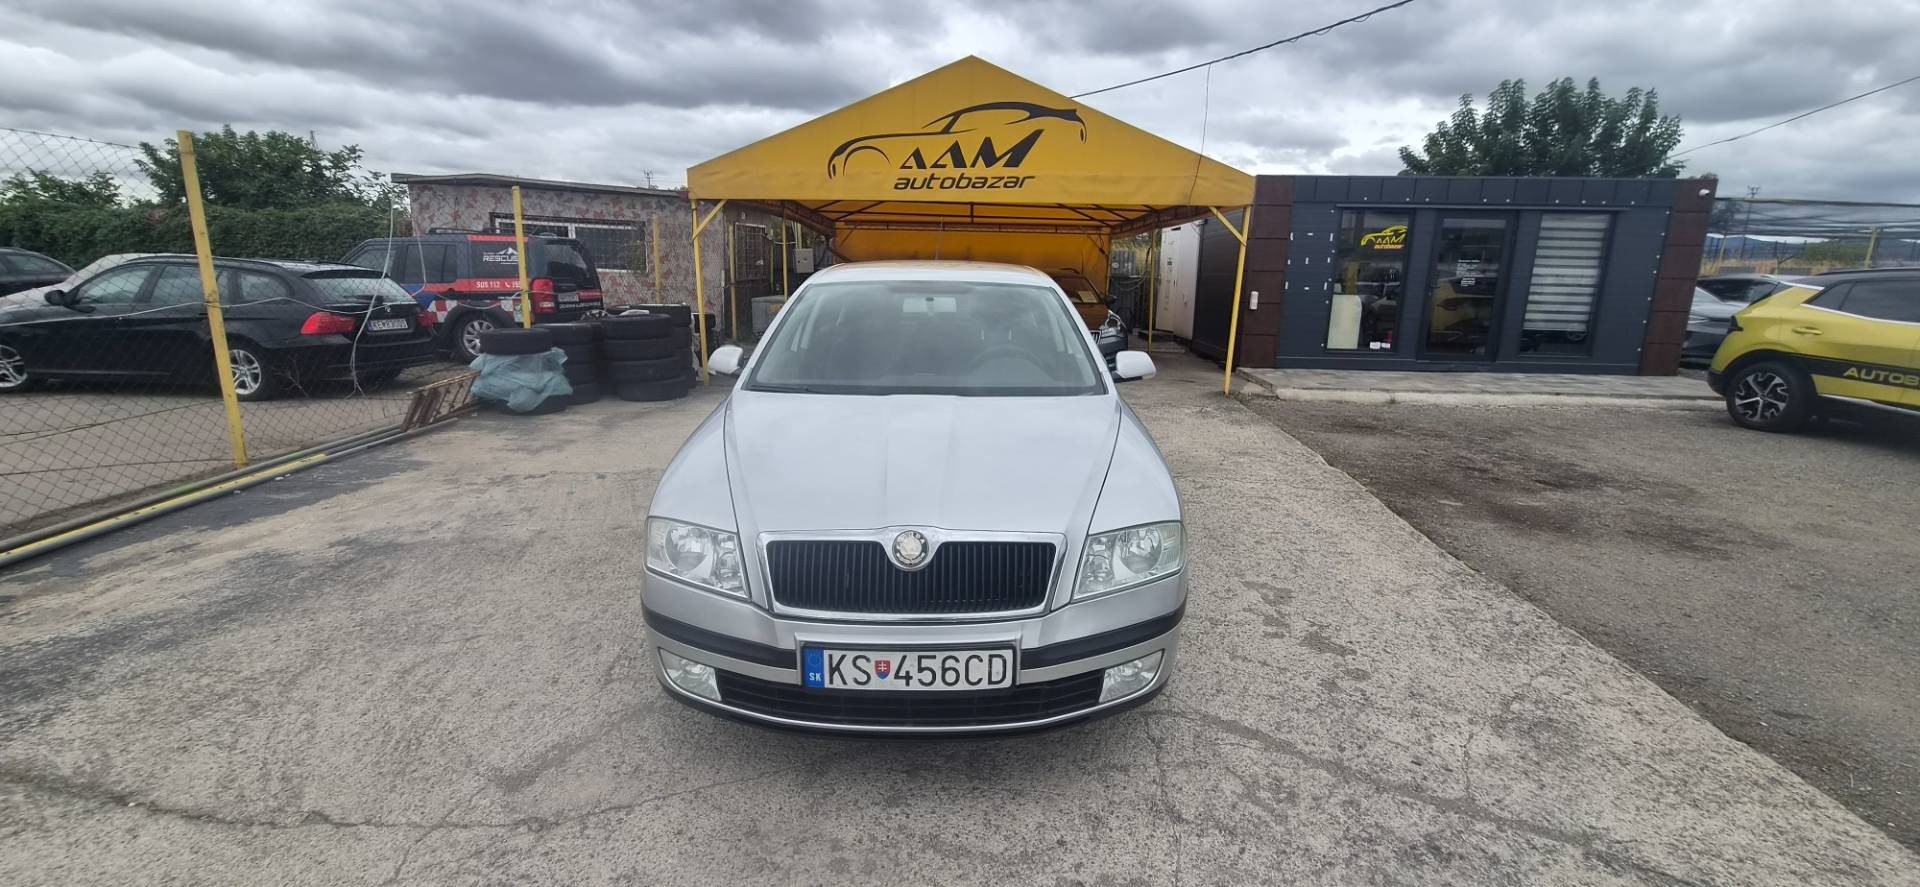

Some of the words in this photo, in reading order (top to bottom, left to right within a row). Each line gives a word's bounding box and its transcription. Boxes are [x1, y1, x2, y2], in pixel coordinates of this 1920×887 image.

[899, 128, 1045, 170] AAM
[893, 172, 1036, 191] autobazar
[808, 672, 822, 682] SK
